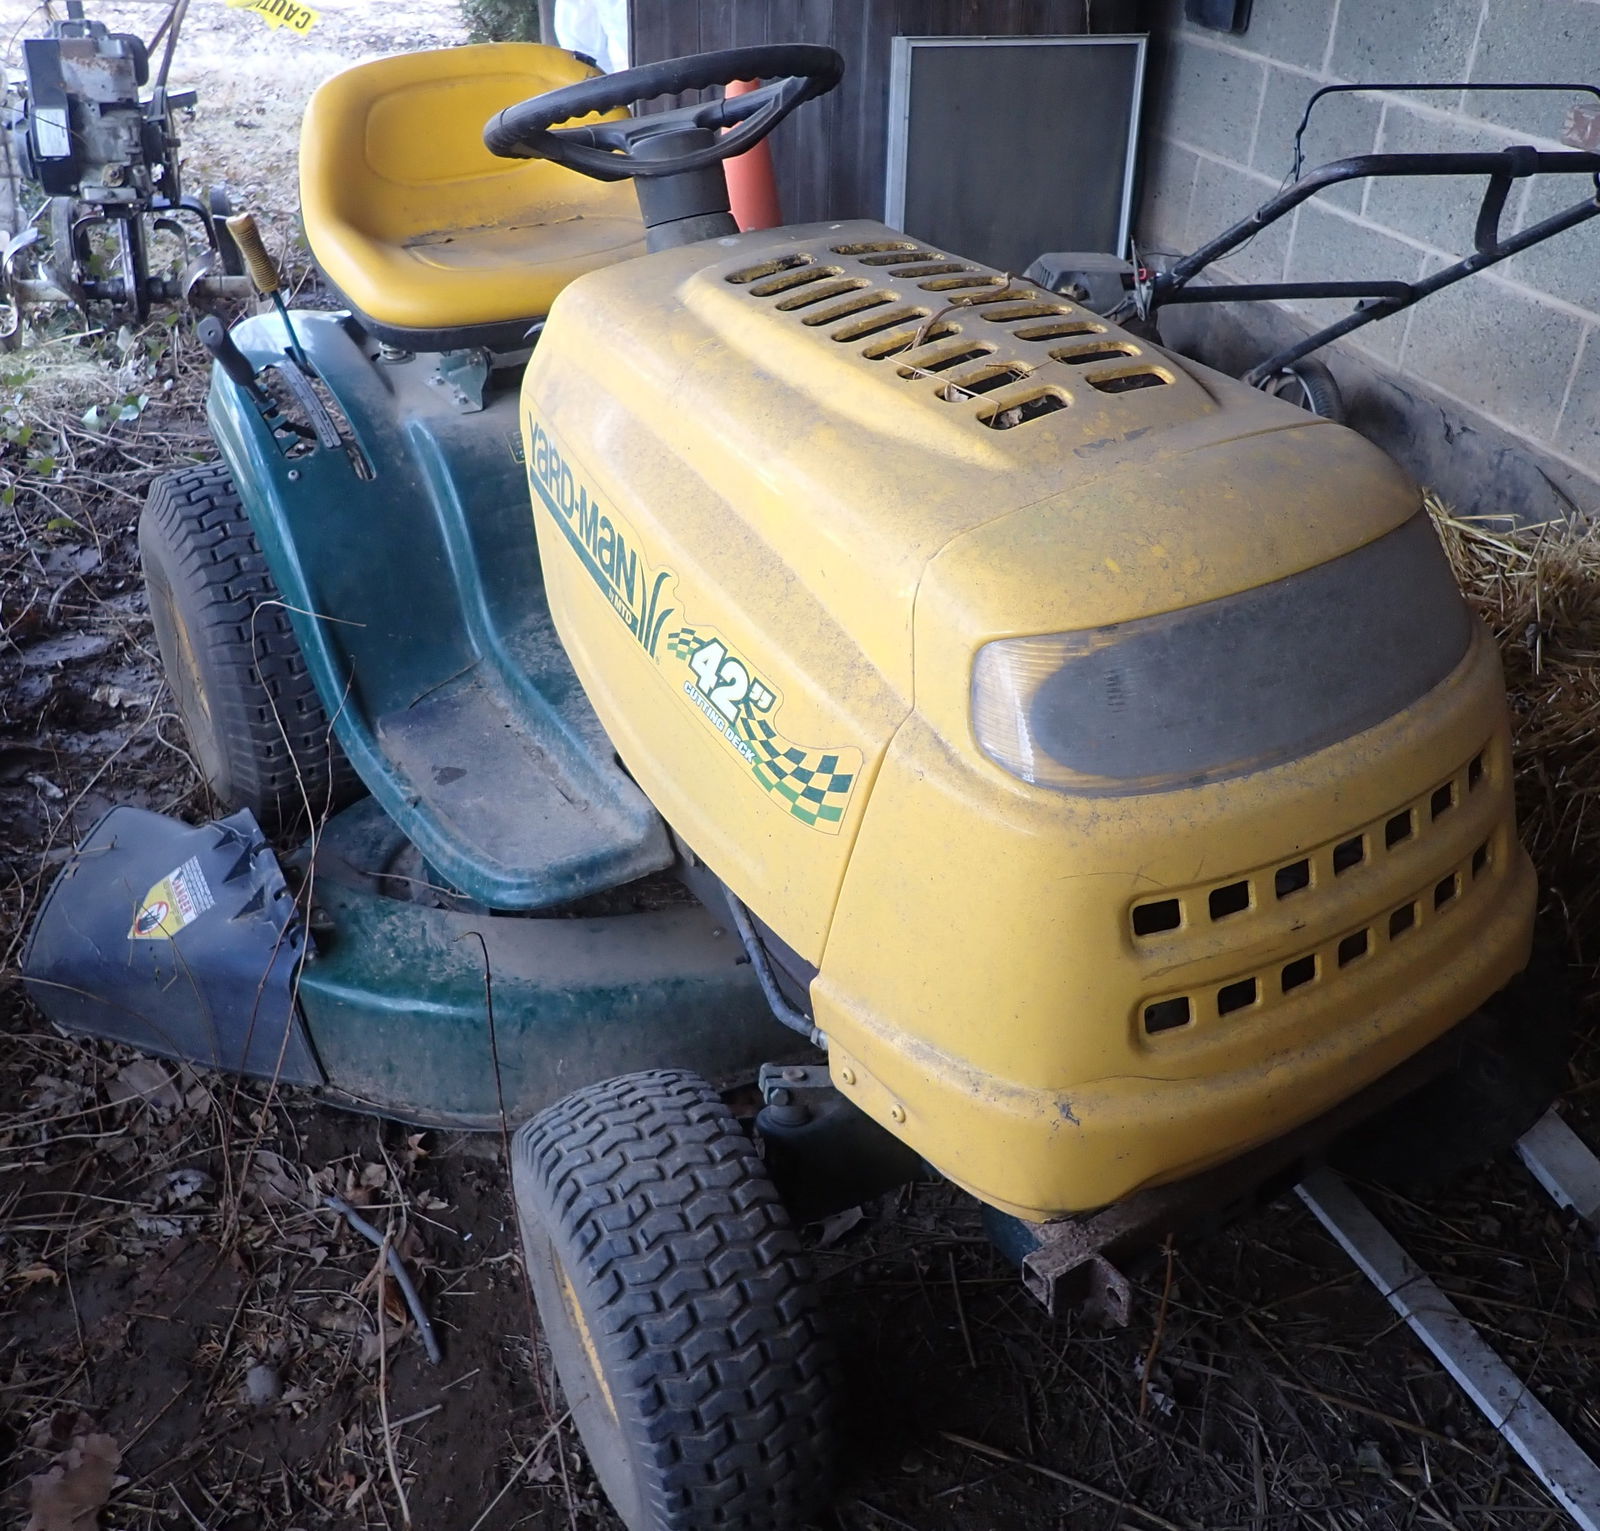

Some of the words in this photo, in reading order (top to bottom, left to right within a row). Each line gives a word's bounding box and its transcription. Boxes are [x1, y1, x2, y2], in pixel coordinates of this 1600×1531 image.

[614, 594, 632, 625] MTD
[684, 680, 726, 732] CUTTING
[724, 728, 757, 764] DECK
[172, 879, 192, 915] DANGER
